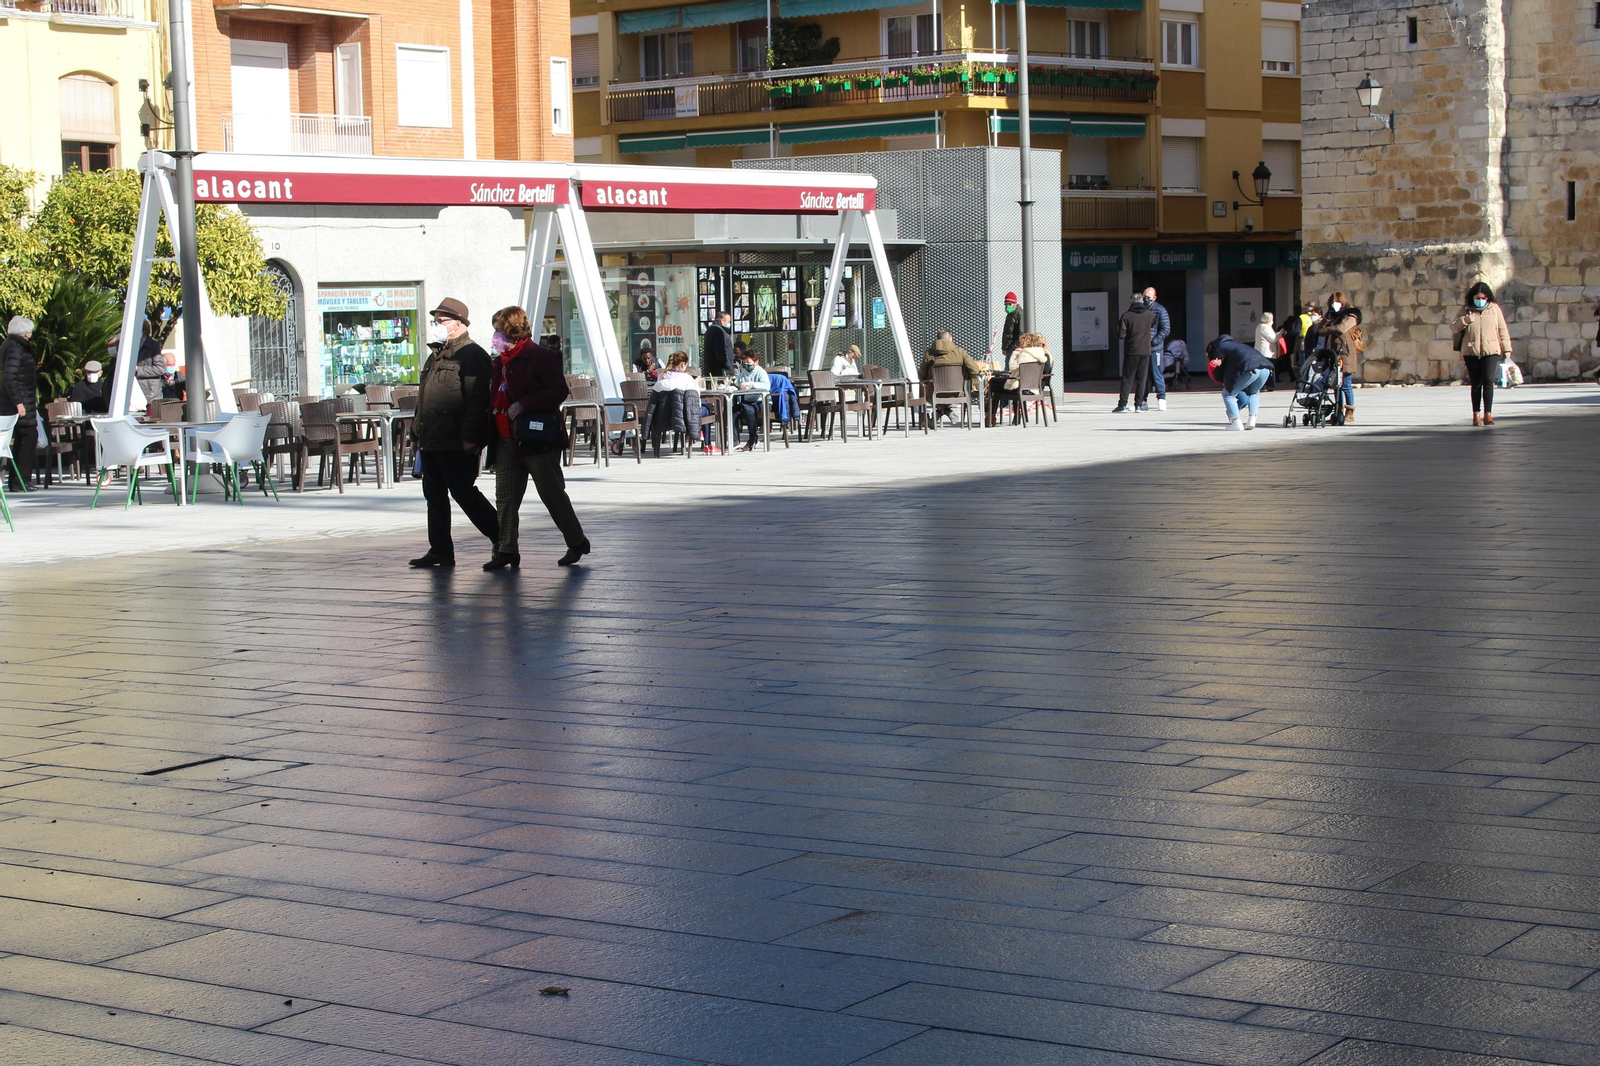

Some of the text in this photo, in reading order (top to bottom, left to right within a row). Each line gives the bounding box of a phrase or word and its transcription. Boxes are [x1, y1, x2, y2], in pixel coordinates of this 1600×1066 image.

[196, 175, 293, 200] alacant
[470, 182, 556, 203] Sánchez Bertelli
[596, 185, 668, 206] alacant
[799, 191, 865, 209] Sánchez Bertelli
[271, 242, 281, 251] 10
[1083, 252, 1118, 268] cajamar
[1161, 250, 1195, 265] cajamar
[387, 289, 415, 298] 30 MINUTOS
[346, 297, 369, 305] TABLETS
[387, 300, 415, 308] 60 MINUTOS
[657, 323, 683, 337] evita
[658, 336, 684, 344] rebrotes
